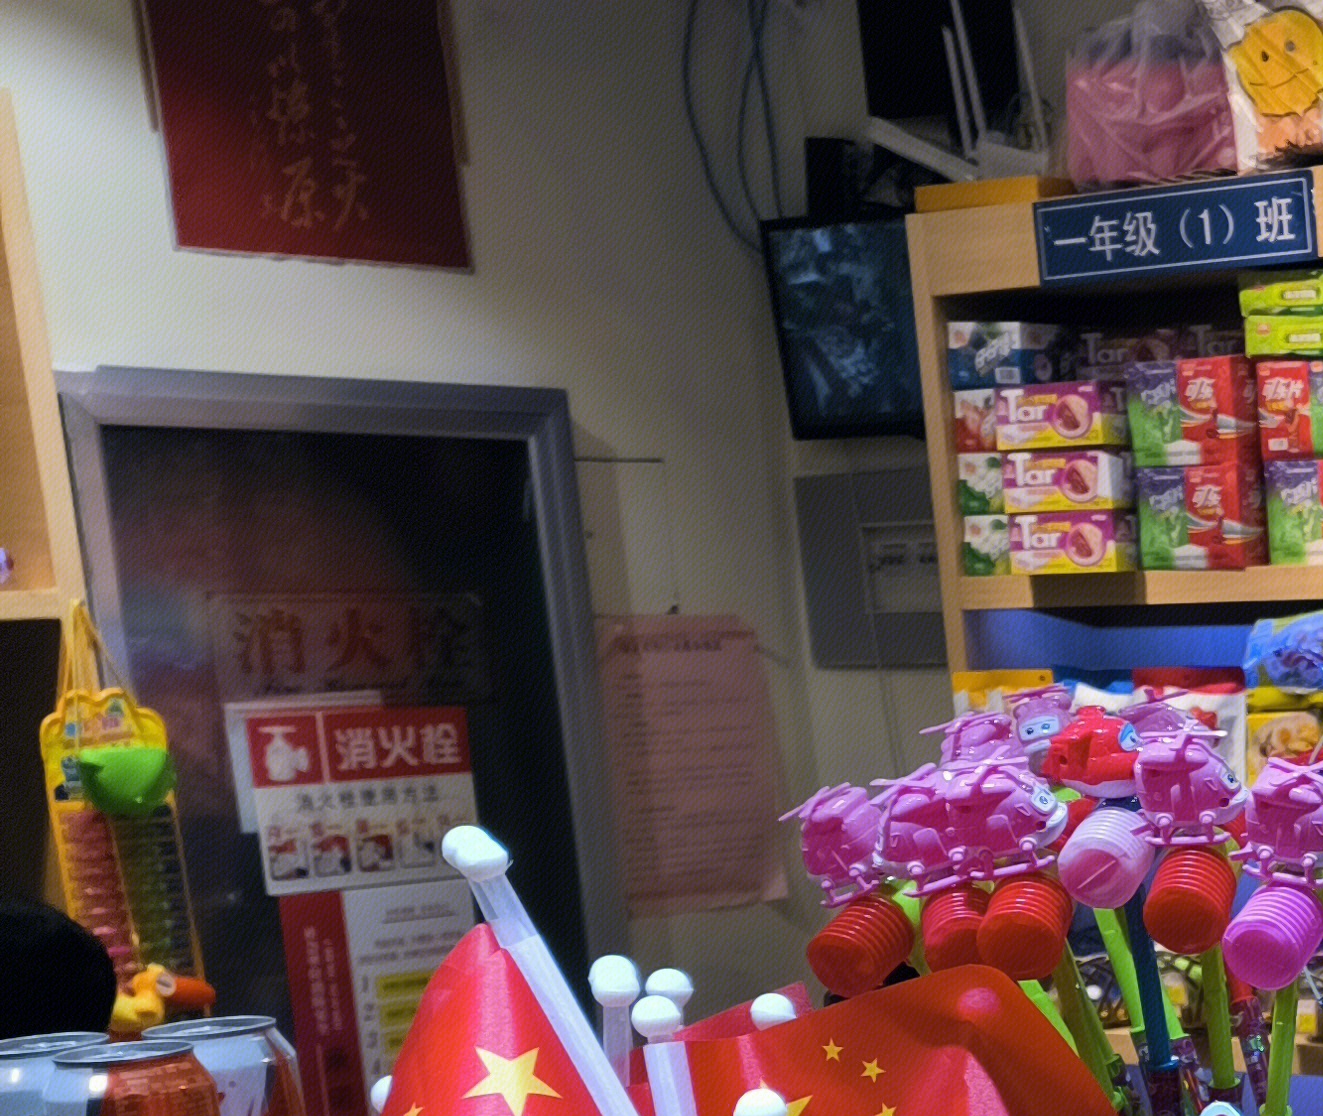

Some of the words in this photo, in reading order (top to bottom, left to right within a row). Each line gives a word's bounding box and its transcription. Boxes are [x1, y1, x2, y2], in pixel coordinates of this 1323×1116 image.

[1053, 197, 1296, 261] 一年级（1）班
[335, 722, 462, 771] 消火栓
